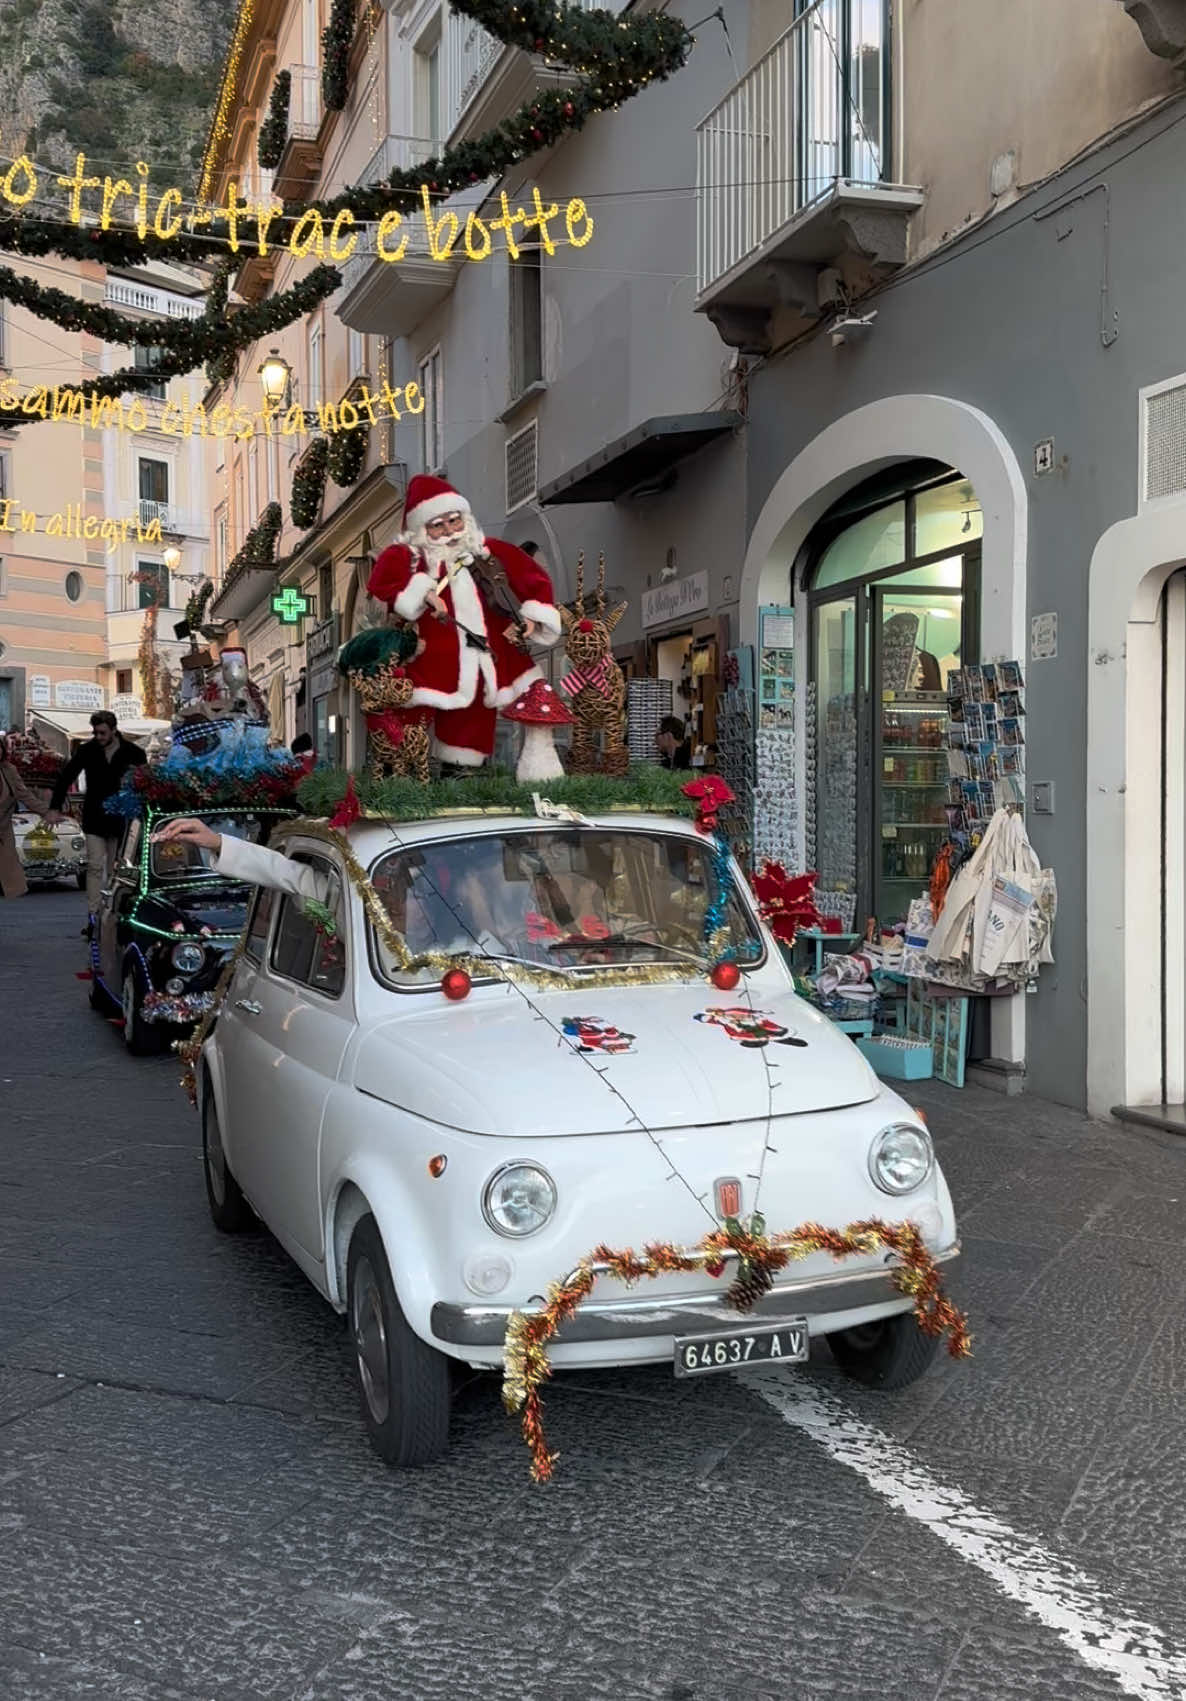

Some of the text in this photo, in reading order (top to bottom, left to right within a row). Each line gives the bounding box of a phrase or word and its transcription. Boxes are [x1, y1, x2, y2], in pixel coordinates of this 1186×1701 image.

[377, 210, 410, 262] e
[421, 184, 594, 260] botte
[160, 391, 307, 439] chesta
[317, 379, 425, 433] notte
[46, 503, 163, 554] allegria
[685, 1339, 756, 1369] 64637
